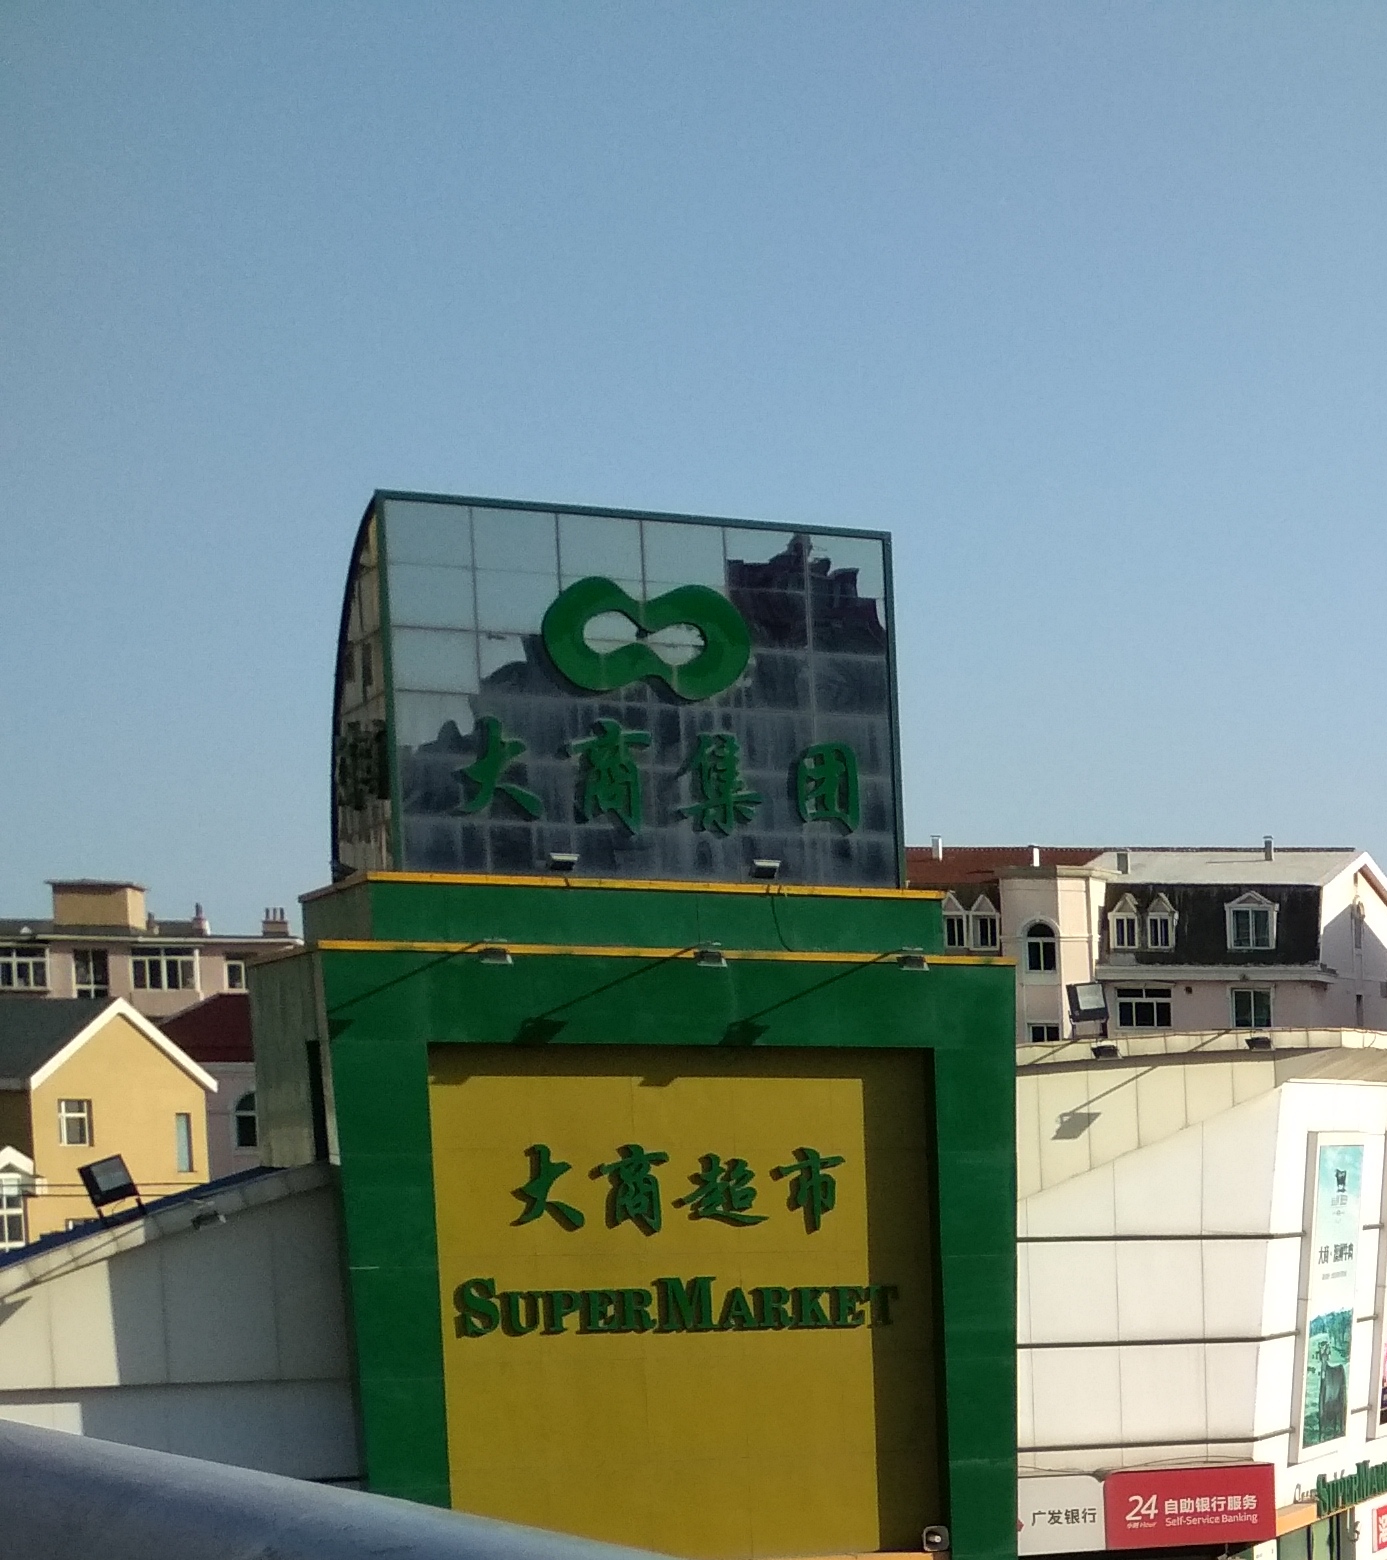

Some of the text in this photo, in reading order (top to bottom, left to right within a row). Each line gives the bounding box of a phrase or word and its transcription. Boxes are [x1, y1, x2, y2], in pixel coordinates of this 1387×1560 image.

[453, 714, 862, 837] 大商集团
[509, 1143, 846, 1237] 大商超市
[1031, 1507, 1097, 1527] 广发银行
[1125, 1494, 1158, 1521] 24
[1164, 1494, 1258, 1516] 自助银行服务
[1165, 1512, 1258, 1527] Self-Service Banking
